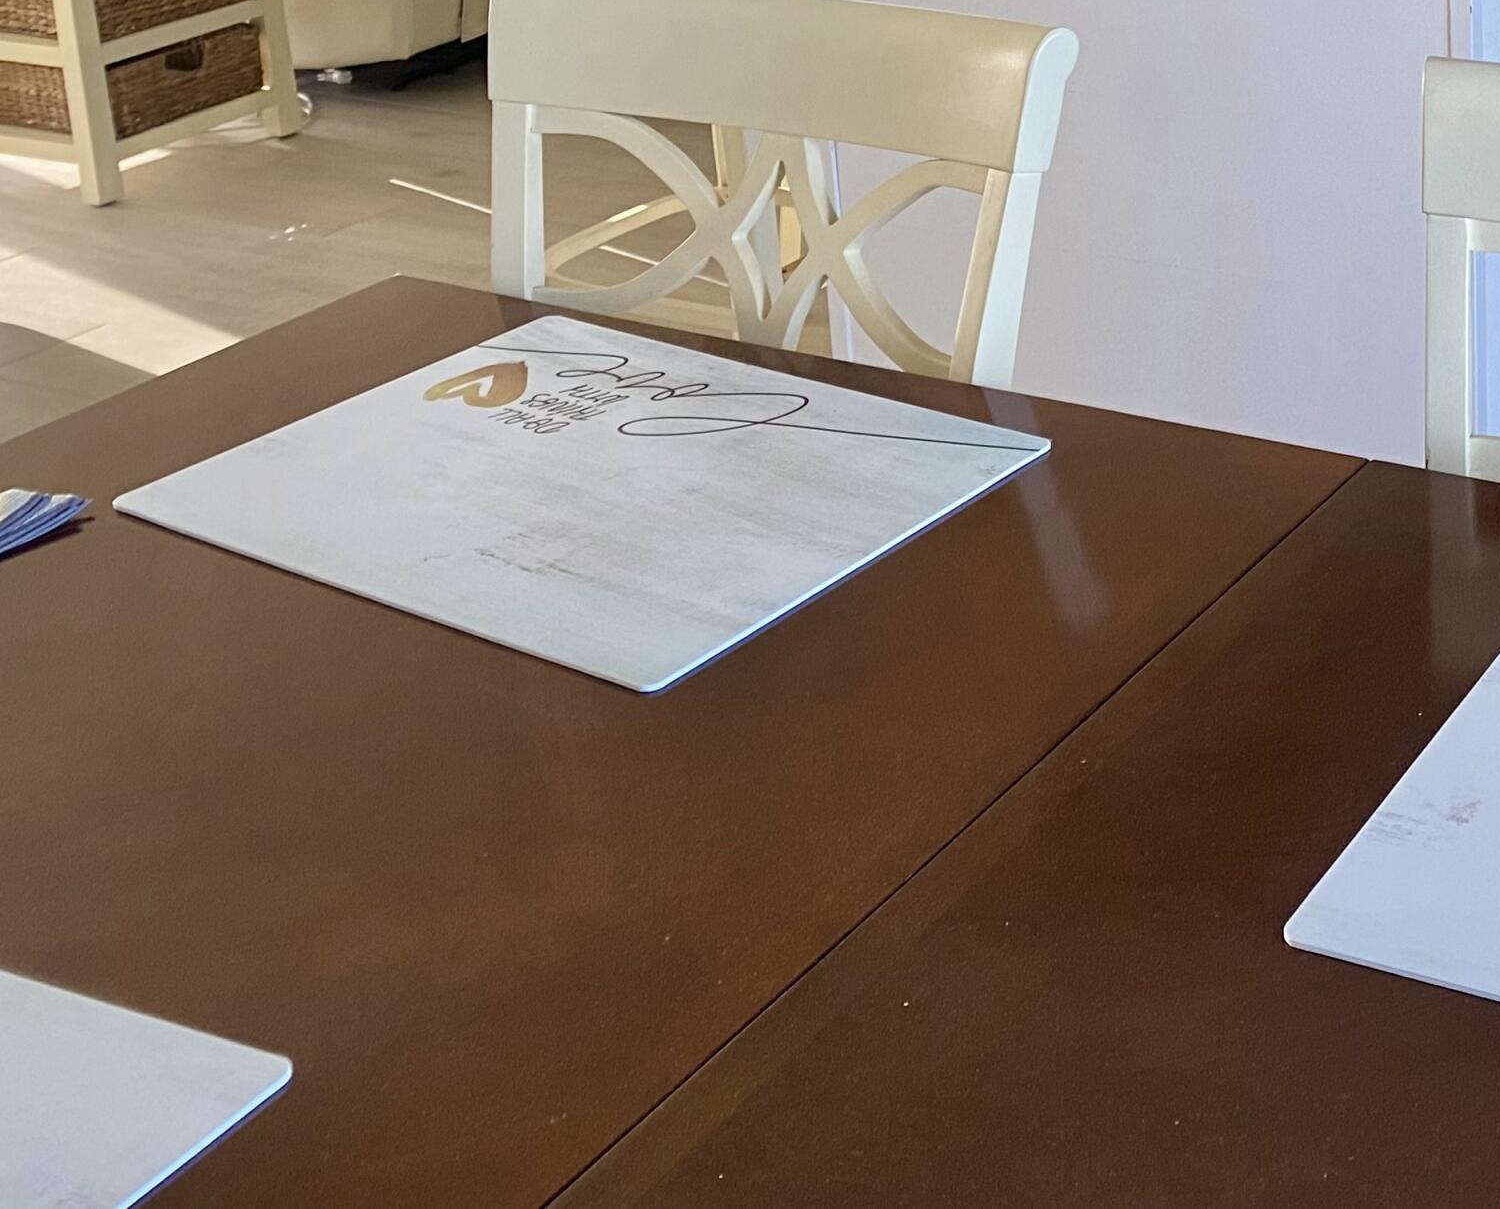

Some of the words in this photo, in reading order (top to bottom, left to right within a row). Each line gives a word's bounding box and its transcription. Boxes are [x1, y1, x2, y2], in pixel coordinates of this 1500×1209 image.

[558, 384, 631, 407] WITH
[488, 407, 535, 429] ALL
[520, 393, 607, 422] THINGS
[524, 418, 570, 434] DO
